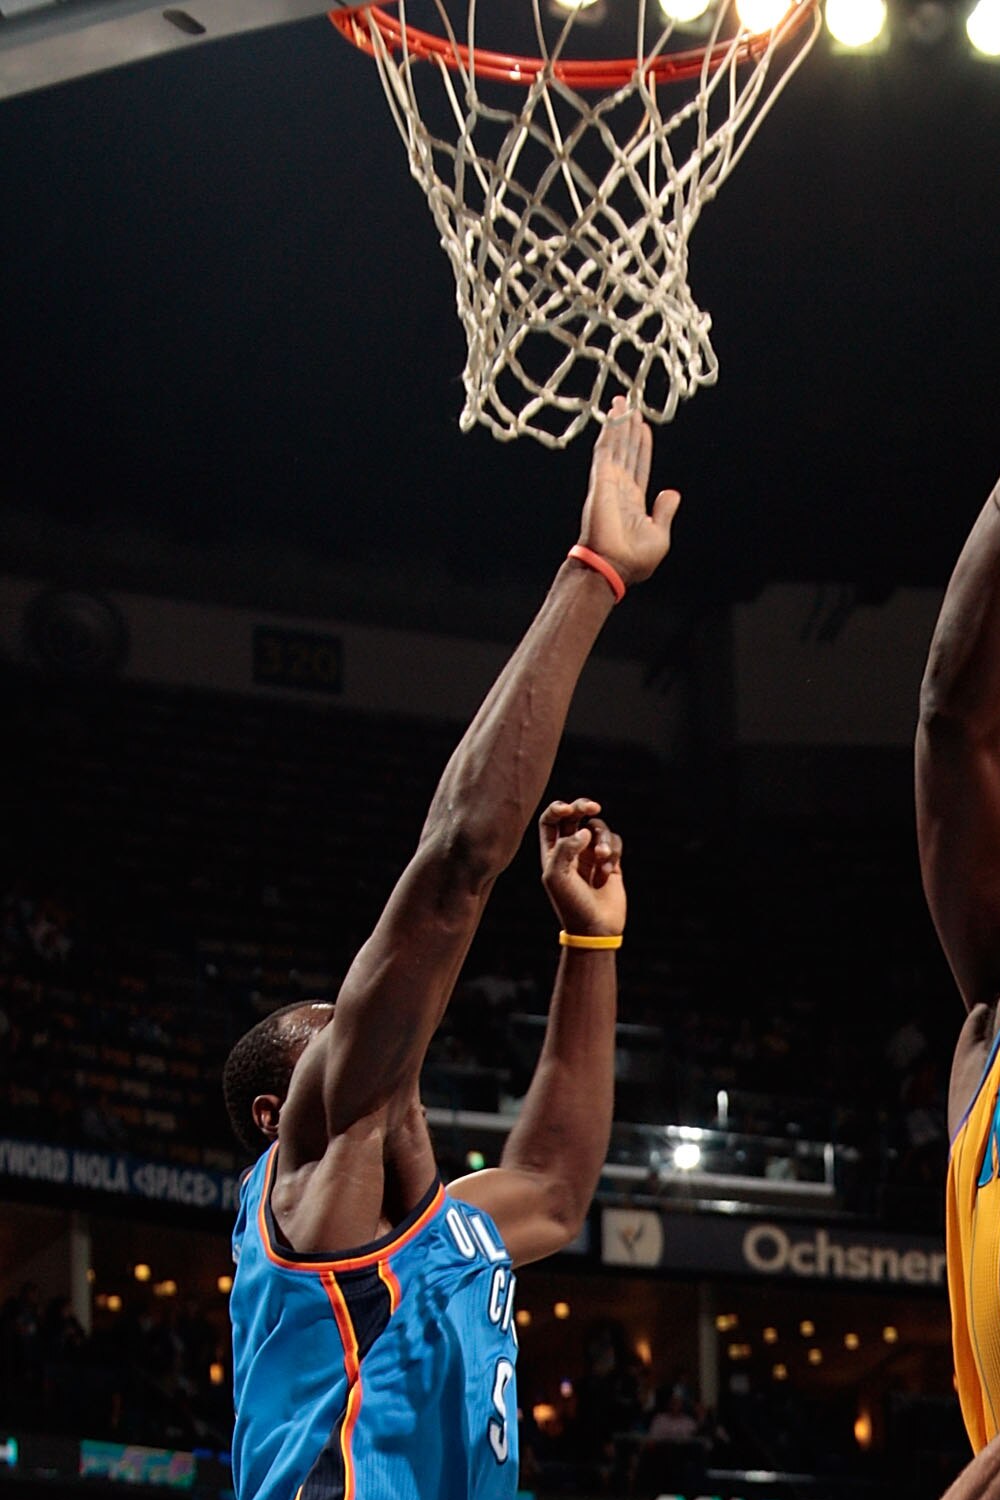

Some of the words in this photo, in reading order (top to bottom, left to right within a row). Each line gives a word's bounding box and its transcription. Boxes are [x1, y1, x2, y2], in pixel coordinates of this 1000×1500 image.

[259, 638, 337, 683] 320
[72, 1151, 129, 1194] NOLA
[742, 1224, 946, 1287] Ochsner
